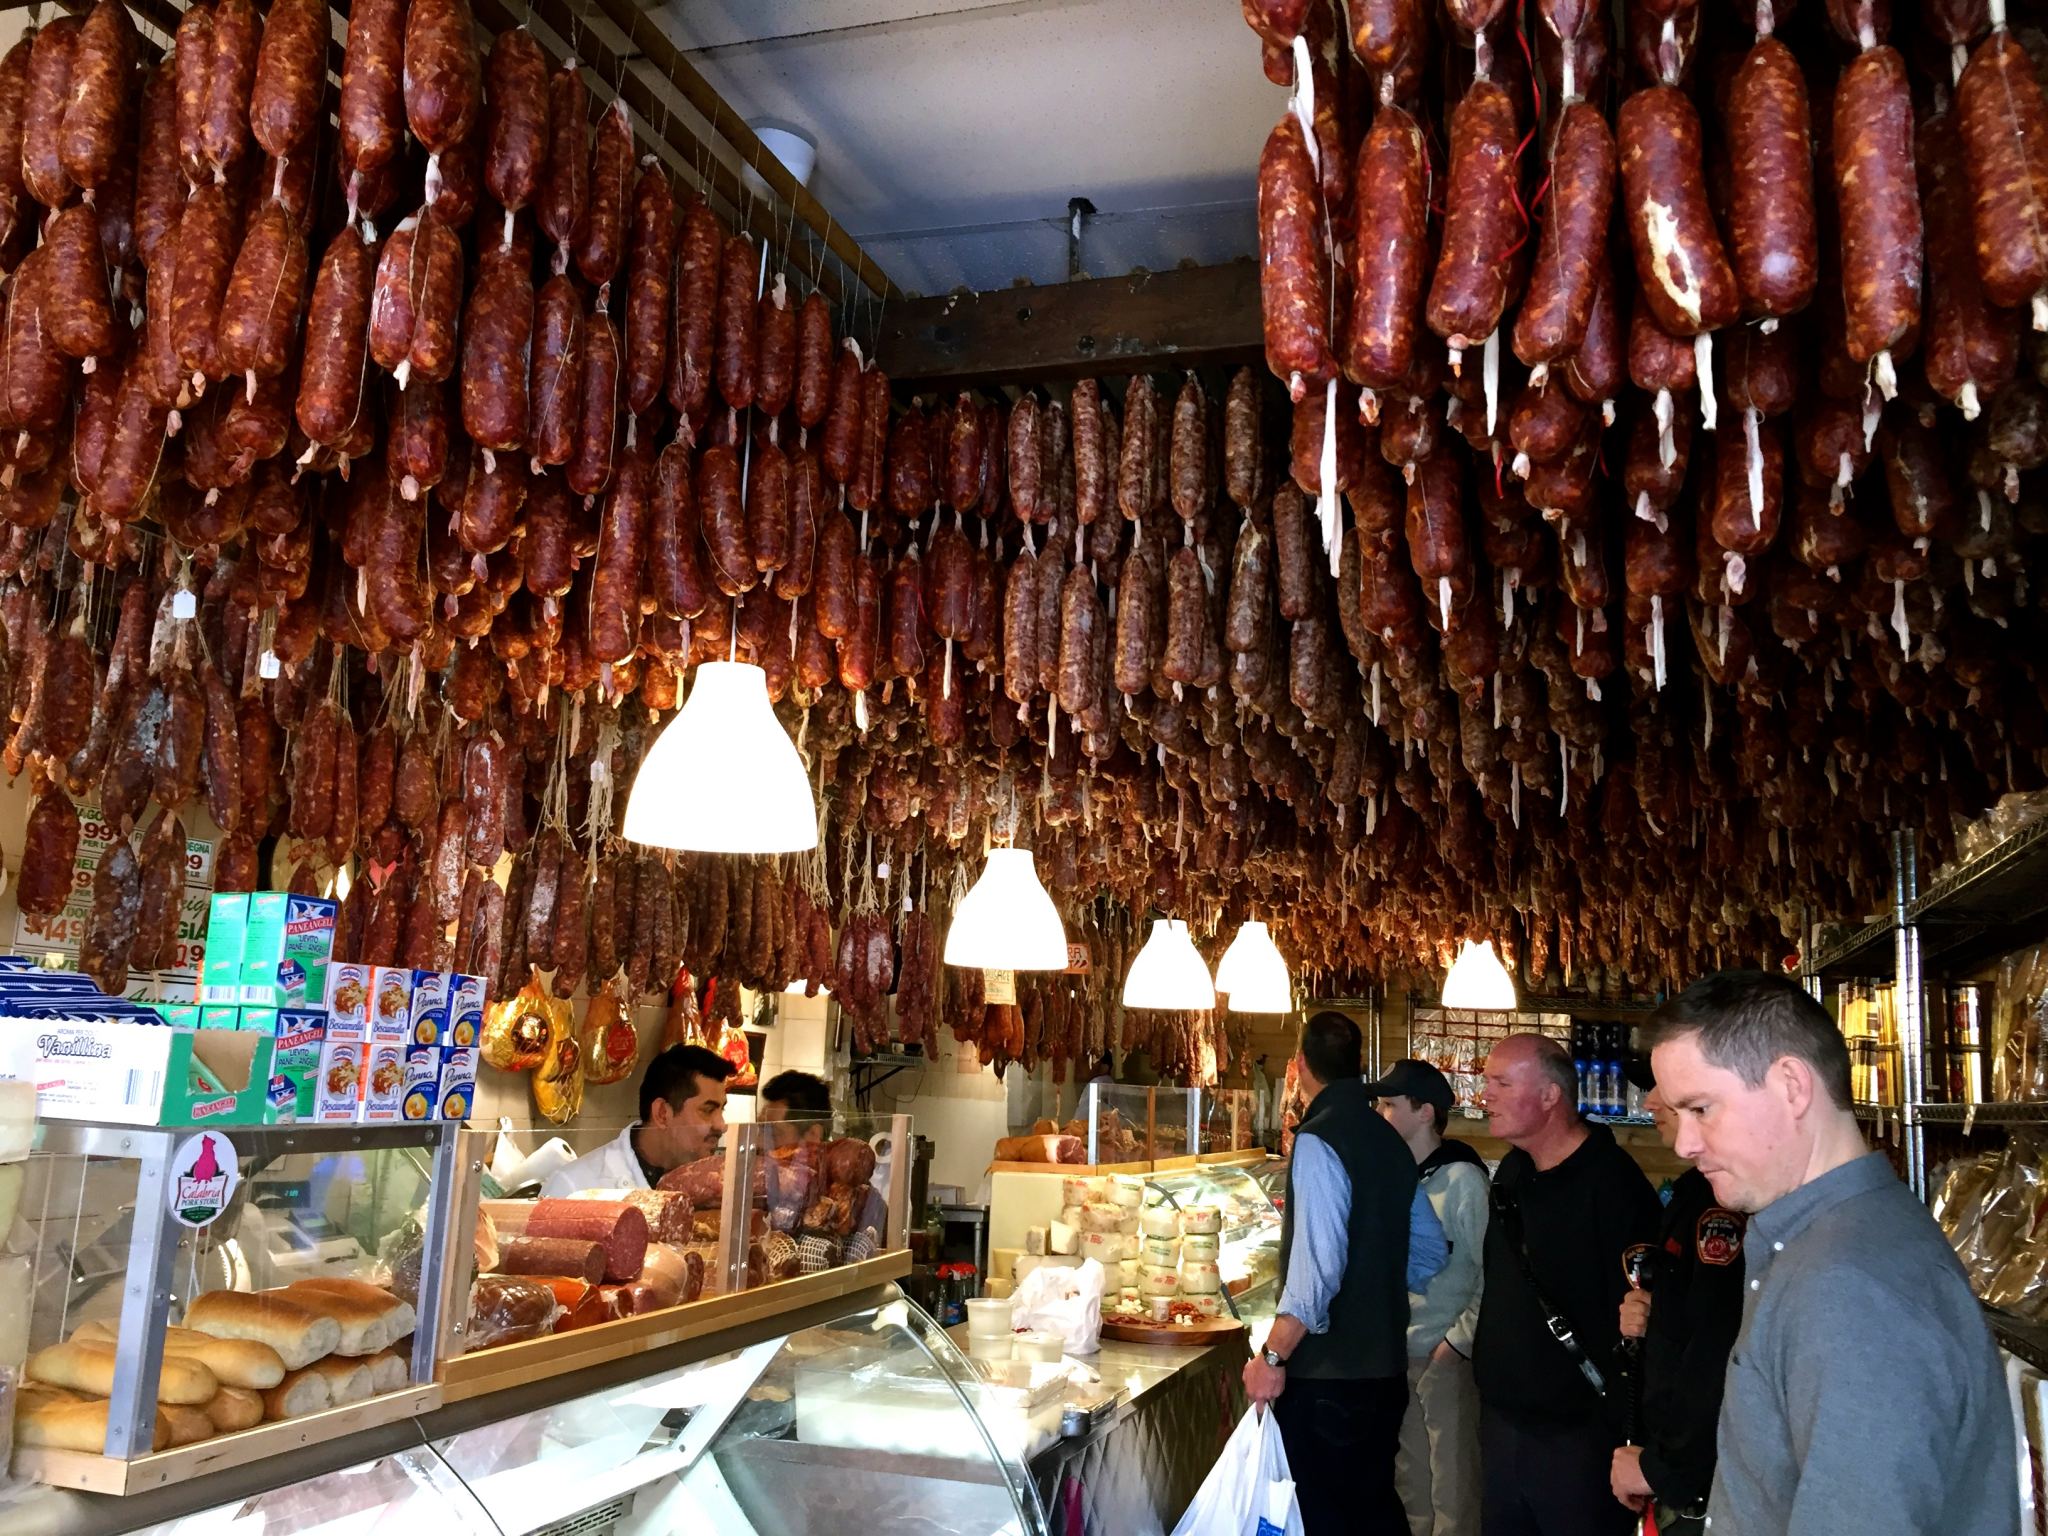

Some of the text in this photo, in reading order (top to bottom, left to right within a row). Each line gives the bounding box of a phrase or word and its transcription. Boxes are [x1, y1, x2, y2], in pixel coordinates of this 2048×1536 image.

[416, 992, 443, 1010] Panna
[37, 1034, 113, 1058] Vanillina
[404, 1066, 433, 1085] Panna
[444, 1067, 472, 1085] Panna
[182, 1185, 220, 1199] Calabria
